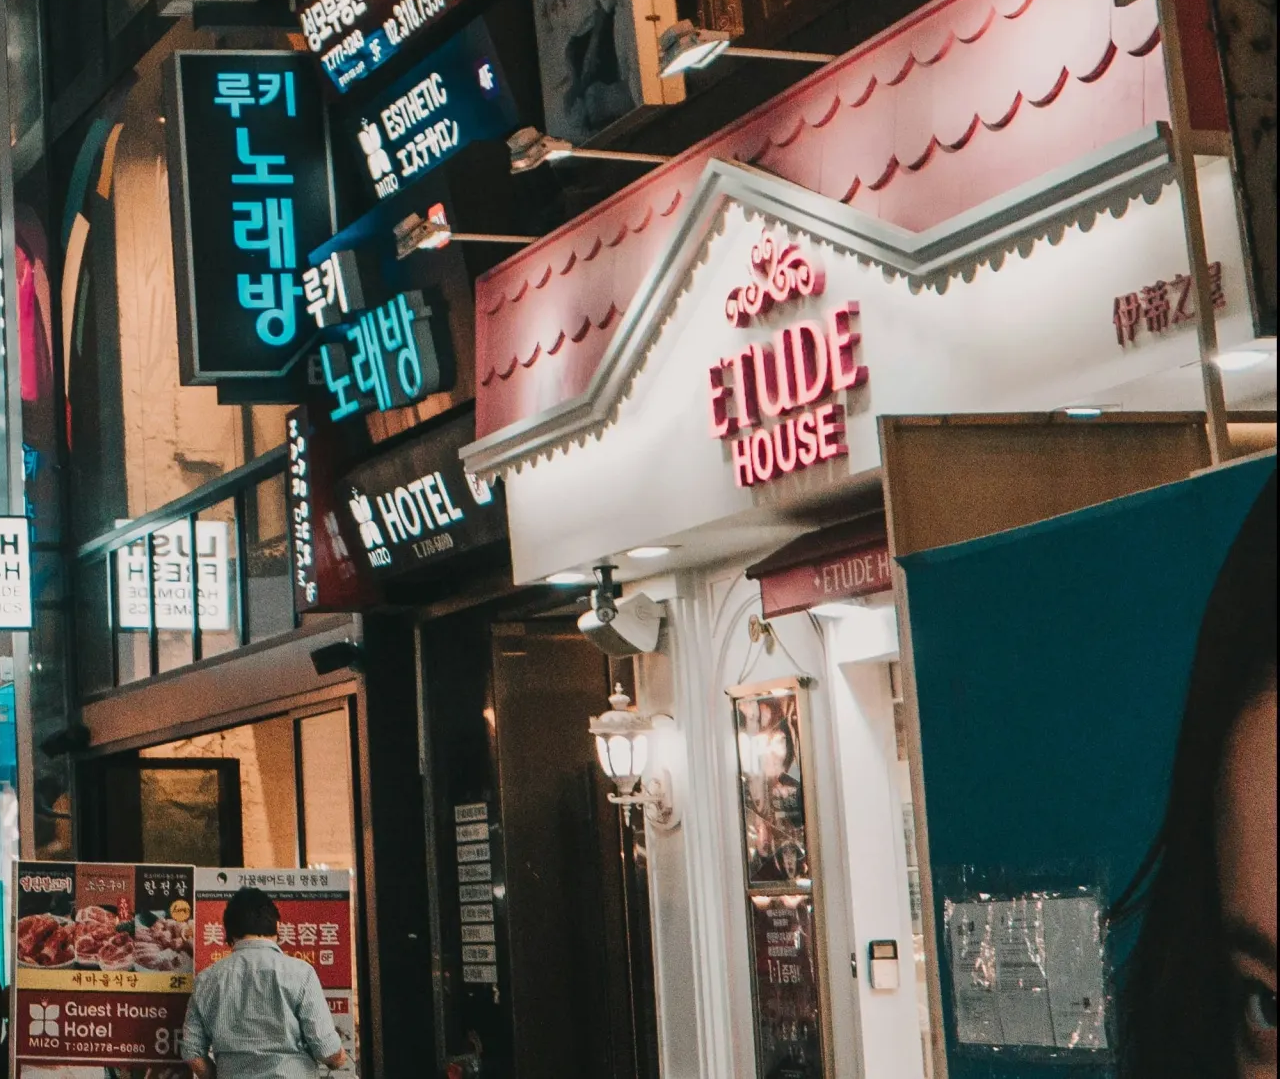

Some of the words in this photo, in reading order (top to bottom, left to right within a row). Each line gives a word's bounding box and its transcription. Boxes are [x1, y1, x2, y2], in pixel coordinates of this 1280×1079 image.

[213, 71, 297, 118] 루키
[379, 72, 448, 142] ESTHETIC
[395, 118, 461, 178] エステサロン
[374, 173, 399, 200] MIZO
[230, 127, 304, 347] 노래방
[302, 252, 351, 328] 루키
[319, 293, 423, 422] 노래방
[709, 302, 867, 439] ETUDE
[731, 404, 847, 488] HOUSE
[377, 472, 465, 544] HOTEL
[368, 547, 392, 569] MIZO
[822, 555, 874, 594] ETUDE
[300, 874, 329, 887] 명동점
[72, 973, 139, 987] 새마을식당
[169, 976, 187, 989] 2F
[64, 1021, 113, 1038] Hotel
[65, 1001, 112, 1018] Guest
[116, 1003, 168, 1019] House
[28, 1037, 60, 1048] MIZO
